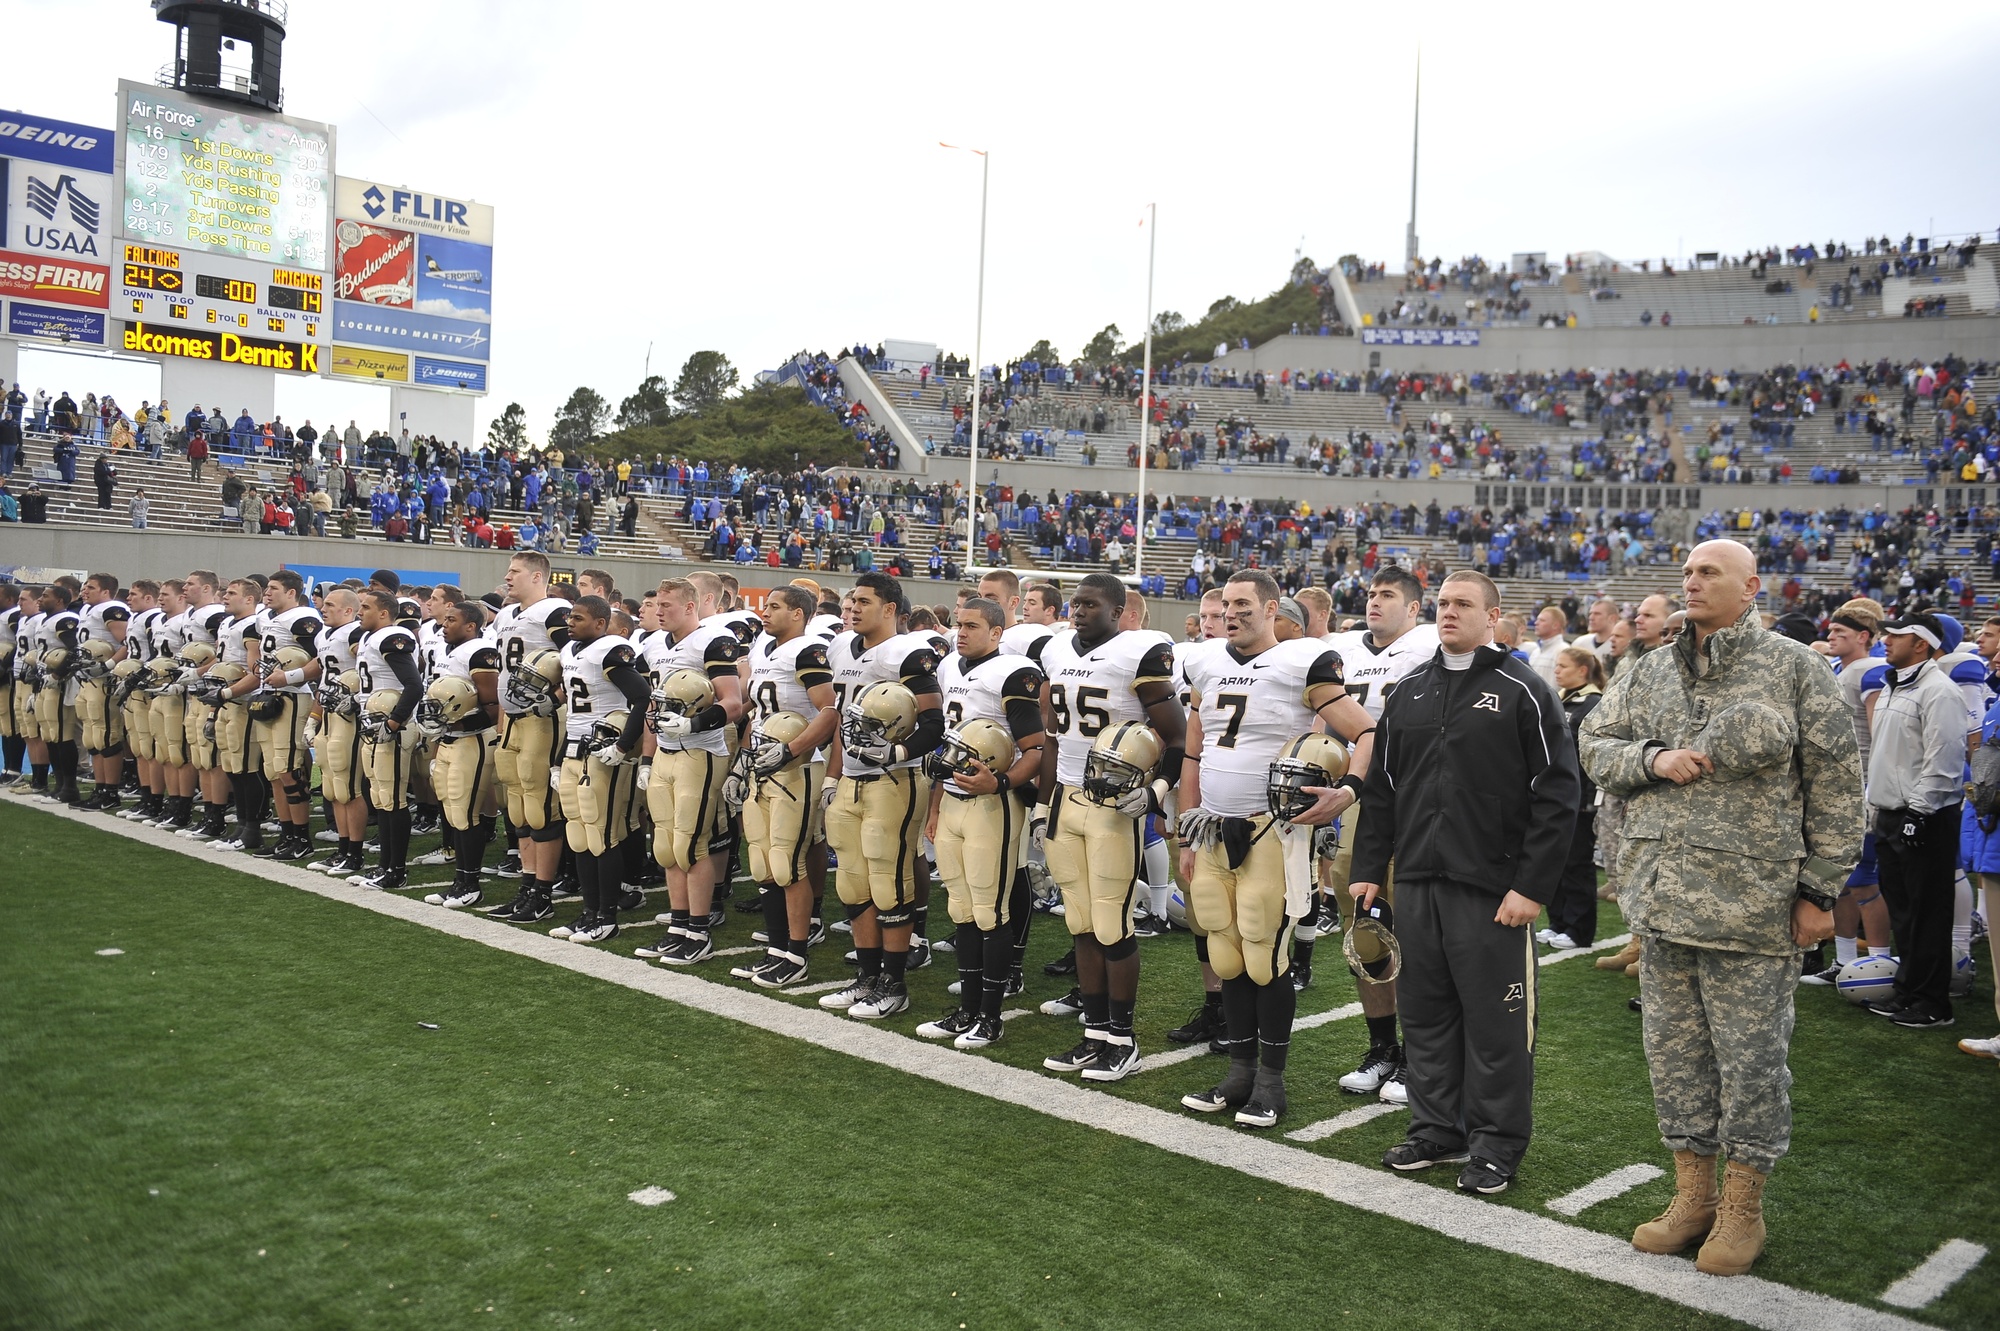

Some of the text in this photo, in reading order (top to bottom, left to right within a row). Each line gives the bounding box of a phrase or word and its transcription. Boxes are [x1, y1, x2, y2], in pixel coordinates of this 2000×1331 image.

[131, 100, 196, 127] Air Force
[144, 125, 164, 140] 16
[138, 143, 169, 160] 179
[192, 137, 274, 166] 1st Downs
[288, 133, 328, 155] Army
[137, 161, 168, 180] 122
[181, 152, 282, 188] Yds Rushing
[297, 155, 317, 171] 20
[146, 183, 157, 197] 2
[181, 170, 280, 205] Yds Passing
[292, 174, 321, 192] 340
[132, 198, 170, 217] 9-17
[190, 190, 271, 219] Turnovers
[392, 190, 469, 227] FLIR
[127, 215, 173, 235] 28:15
[187, 208, 272, 236] 3rd Downs
[391, 214, 470, 236] Extraordinary Vision
[25, 225, 98, 257] USAA
[187, 226, 271, 253] Poss Time
[124, 245, 179, 269] FALCONS
[334, 234, 412, 299] Budweiser
[125, 265, 153, 288] 24
[273, 268, 322, 291] KNIGHTS
[123, 289, 154, 300] DOWN
[164, 295, 177, 303] TO
[302, 291, 321, 313] 14
[133, 300, 142, 313] 4
[257, 308, 296, 320] BALL ON
[207, 310, 215, 323] 3
[218, 314, 236, 323] TOL
[239, 314, 247, 327] 0
[268, 318, 284, 332] 44
[302, 314, 320, 323] QTR
[307, 324, 315, 337] 4
[340, 320, 463, 344] LOCKHEED MARTIN
[124, 321, 318, 372] elcomes Dennis K
[356, 359, 406, 372] Pizza Hut
[435, 368, 478, 380] BOEING
[840, 669, 864, 678] ARMY
[1059, 668, 1094, 679] ARMY
[1217, 676, 1259, 687] ARMY
[1353, 666, 1391, 678] ARMY
[948, 686, 970, 696] ARMY
[1049, 684, 1110, 738] 95
[1216, 692, 1249, 750] 7
